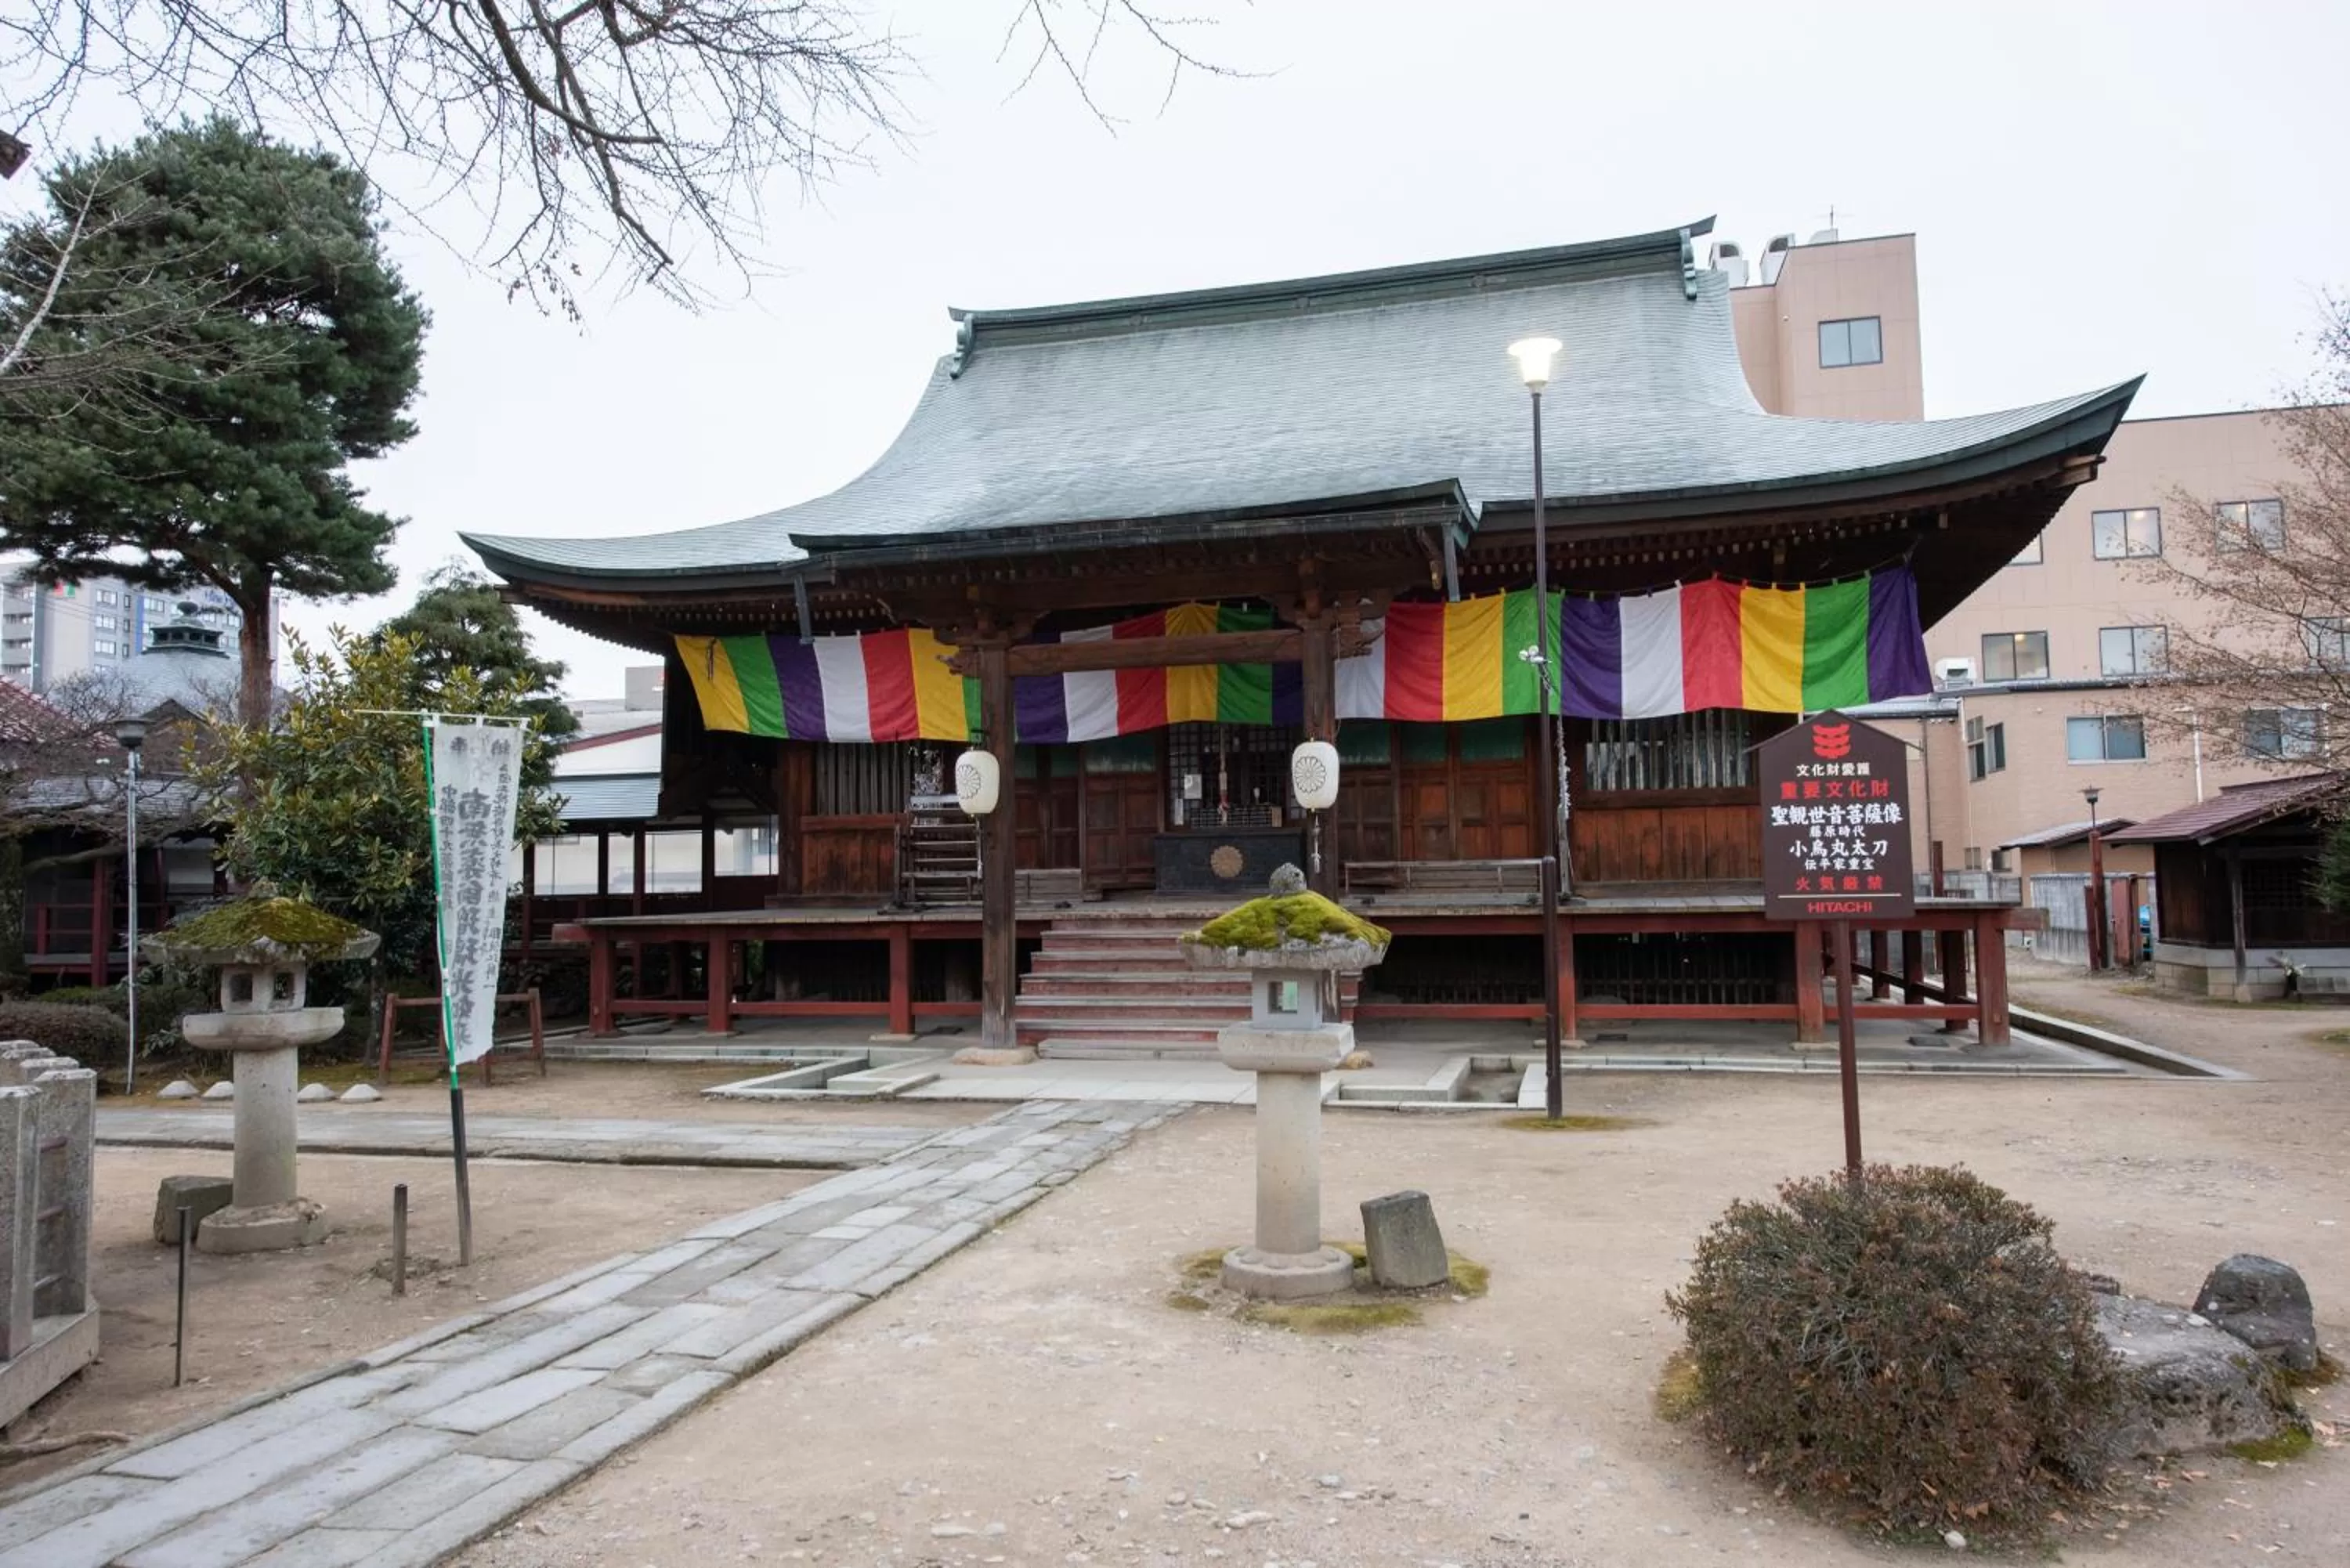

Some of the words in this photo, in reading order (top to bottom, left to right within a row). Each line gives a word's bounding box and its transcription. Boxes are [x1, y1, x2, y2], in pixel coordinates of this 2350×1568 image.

[1796, 763, 1871, 777] 文化財愛護
[1781, 779, 1889, 800] 重要文化財
[1771, 803, 1904, 826] 聖観世音菩薩像
[1810, 825, 1866, 837] 藤原時代
[1804, 858, 1875, 871] 伝平家重宝
[1796, 876, 1883, 891] 火気厳禁
[1807, 901, 1872, 913] HITACHI
